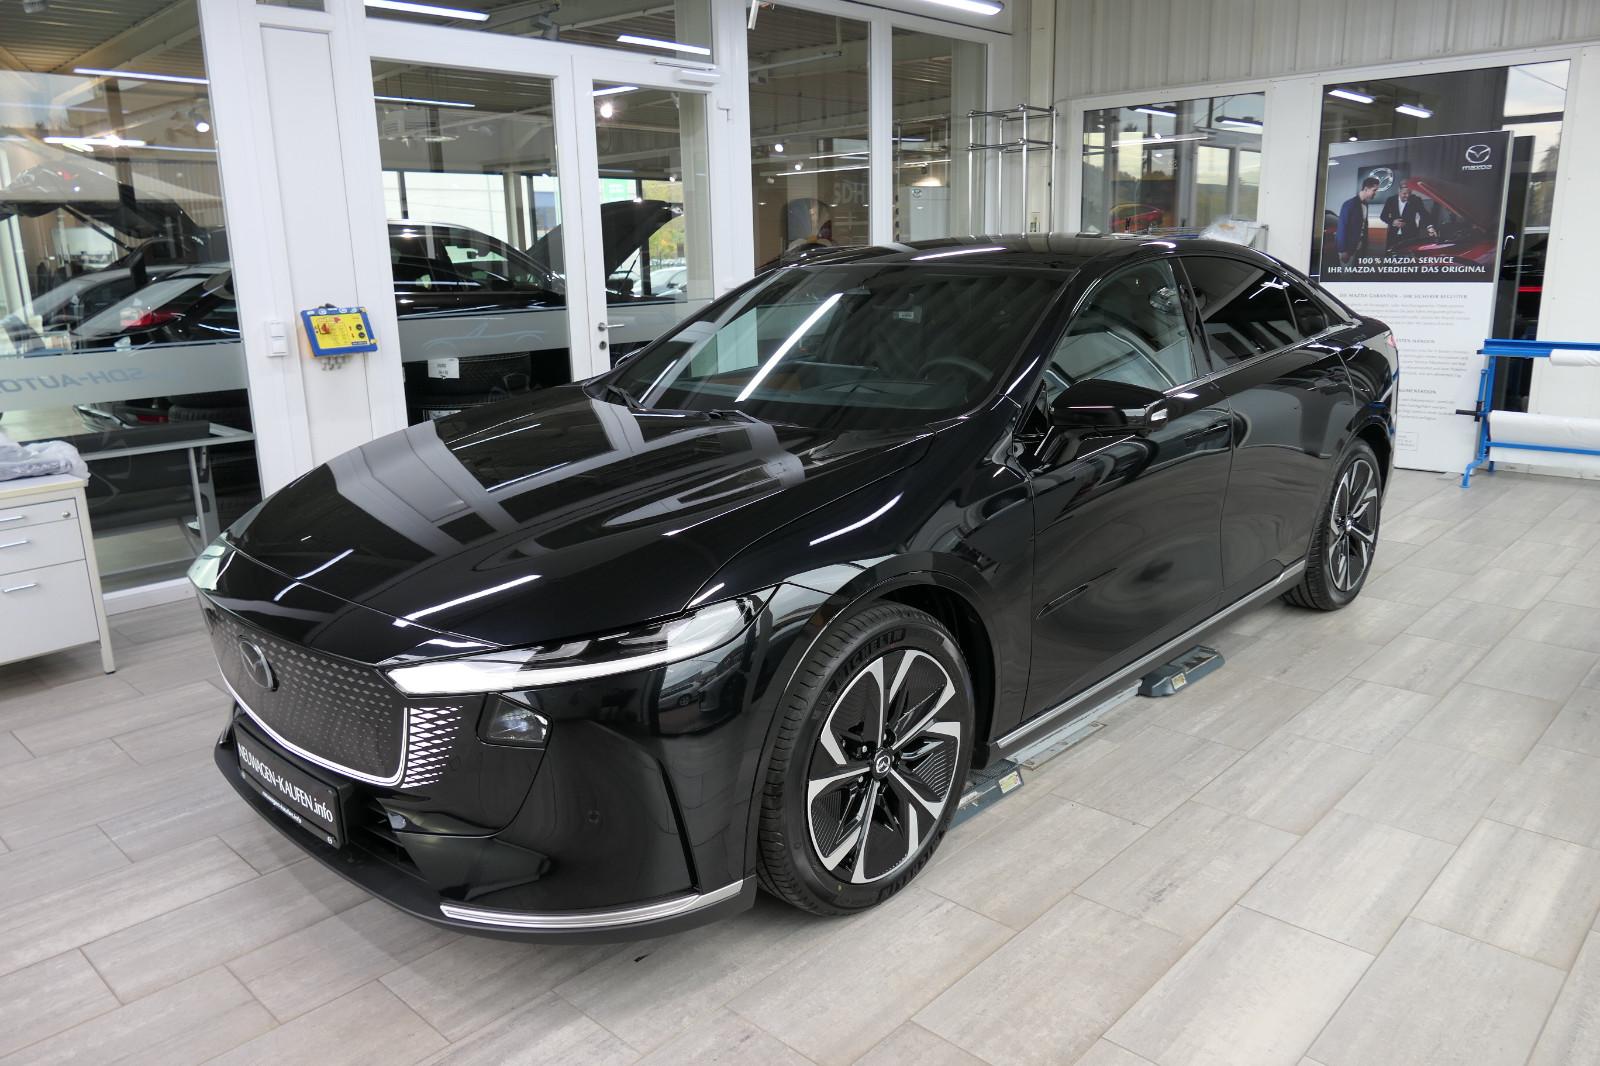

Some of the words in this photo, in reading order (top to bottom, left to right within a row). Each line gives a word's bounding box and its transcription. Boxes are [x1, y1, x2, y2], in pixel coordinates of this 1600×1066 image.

[1358, 257, 1374, 265] 100
[1383, 256, 1417, 264] MAZDA
[1418, 256, 1454, 264] SERVICE
[1441, 265, 1486, 273] ORIGINAL
[237, 741, 334, 823] NEUWAGEN-KAUFEN.info
